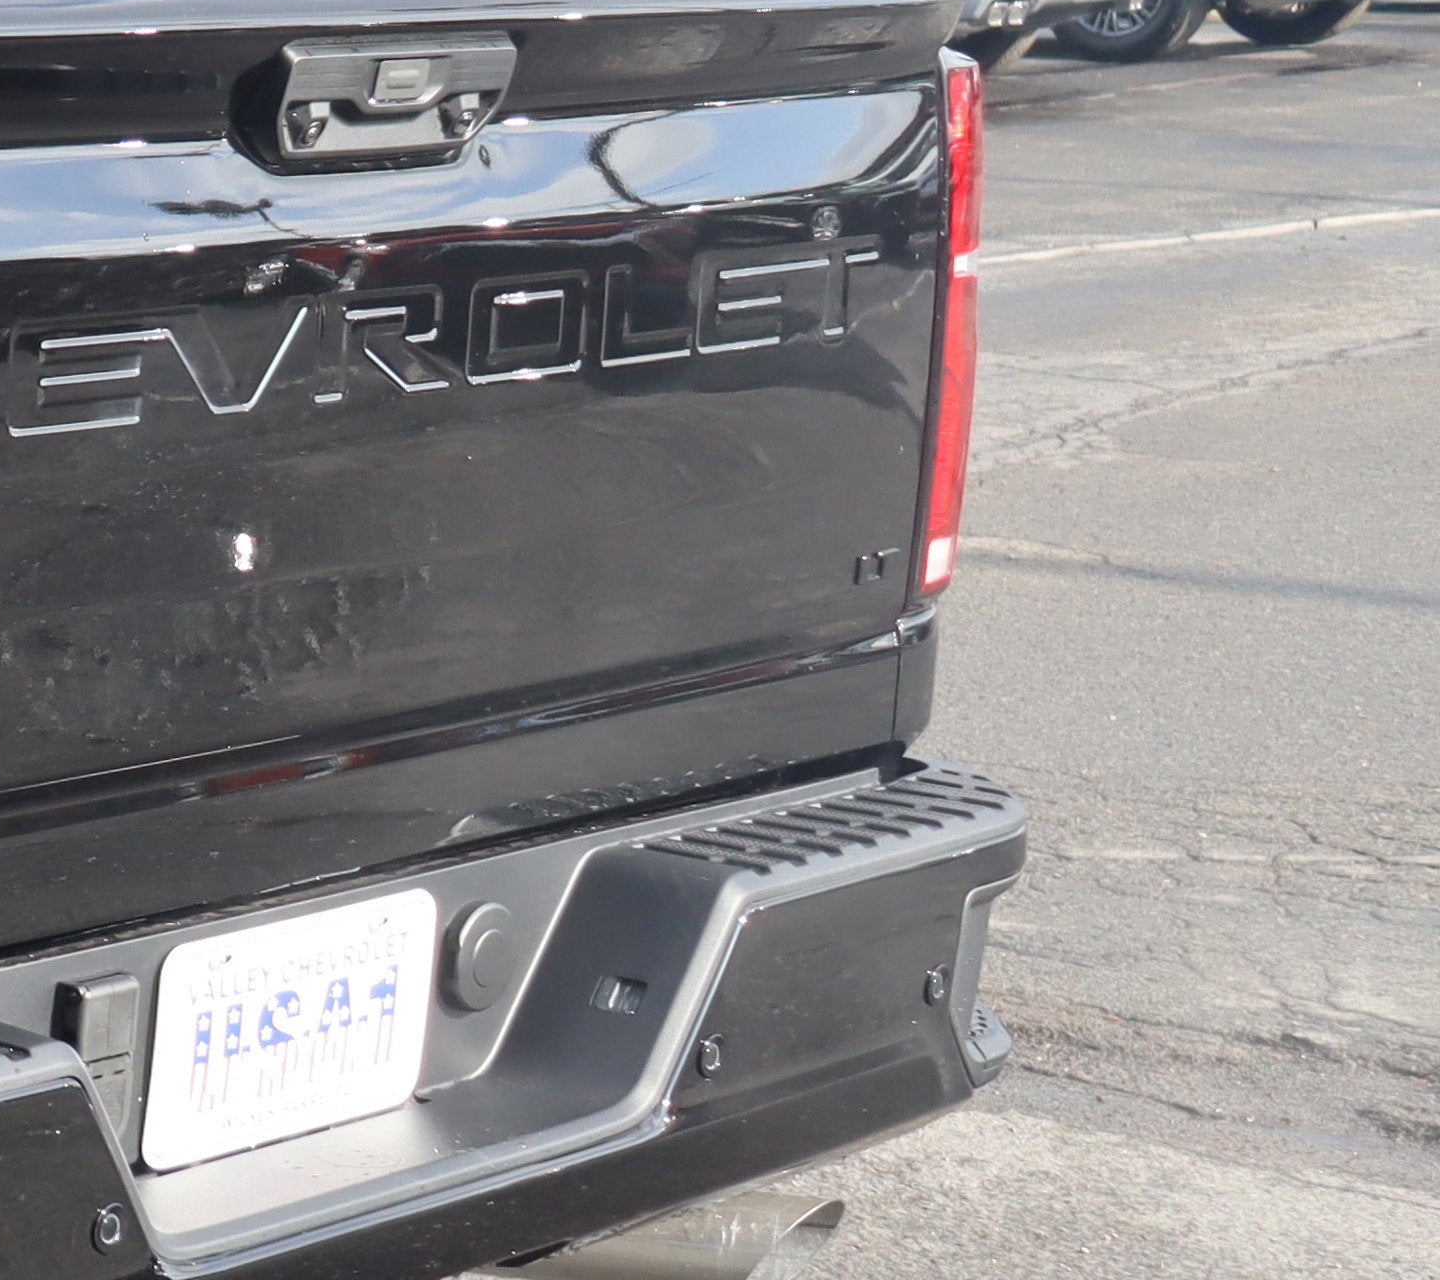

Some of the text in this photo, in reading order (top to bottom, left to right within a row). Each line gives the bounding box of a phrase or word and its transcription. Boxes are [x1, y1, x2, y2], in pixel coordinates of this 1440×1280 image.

[853, 547, 900, 586] LT
[188, 930, 410, 1006] VALLEY CHEVROLET
